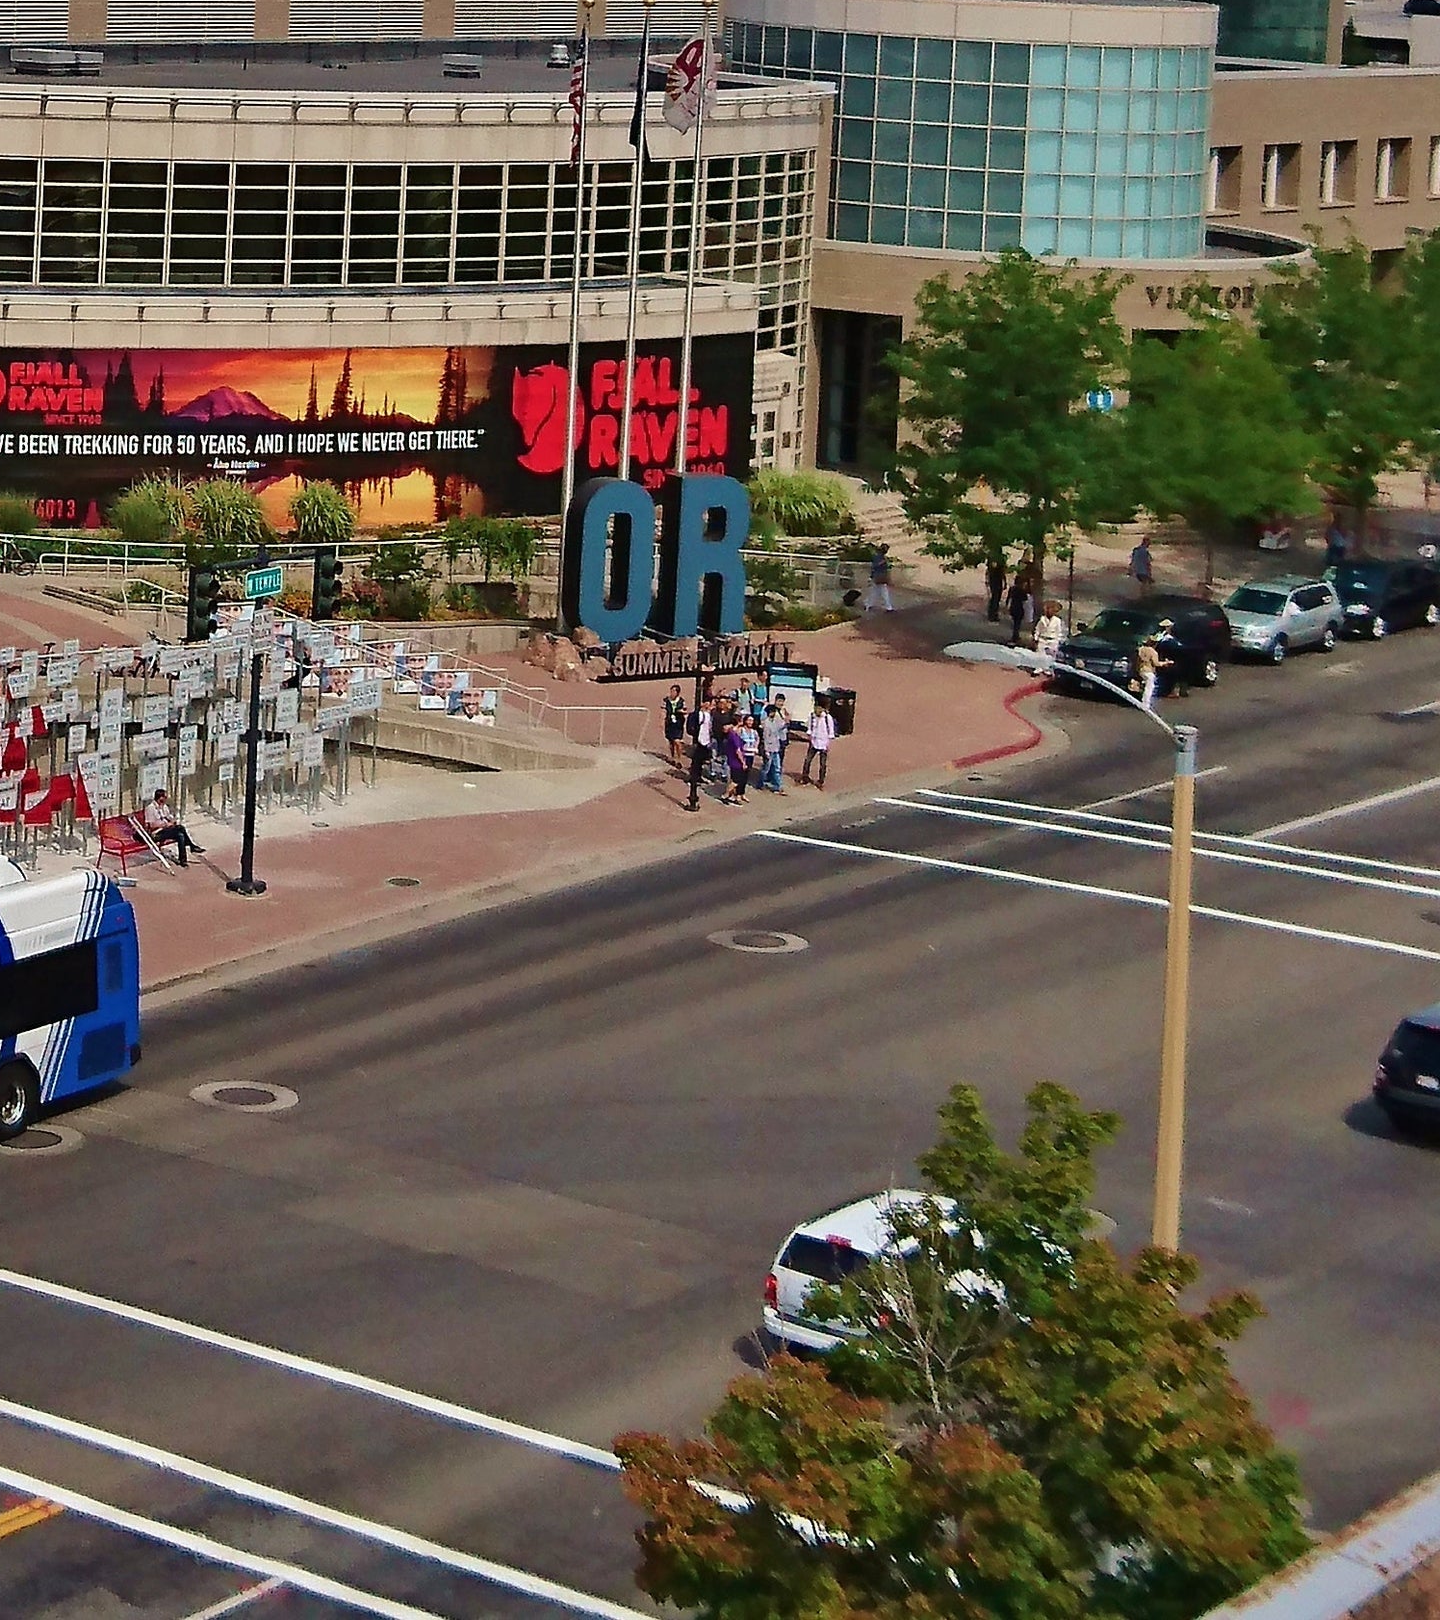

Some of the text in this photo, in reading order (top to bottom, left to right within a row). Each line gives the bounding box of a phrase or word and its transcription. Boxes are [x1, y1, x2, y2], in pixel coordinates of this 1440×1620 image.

[18, 434, 59, 455] BEEN
[63, 435, 138, 455] TREKKING
[142, 435, 173, 455] FOR
[177, 435, 196, 455] 50
[199, 435, 251, 456] YEARS,
[254, 434, 283, 454] AND
[287, 434, 293, 453] I
[297, 433, 334, 453] HOPE
[337, 432, 359, 453] WE
[362, 431, 405, 452] NEVER
[408, 430, 434, 451] GET
[570, 473, 751, 643] OR
[613, 652, 698, 677] SUMMER
